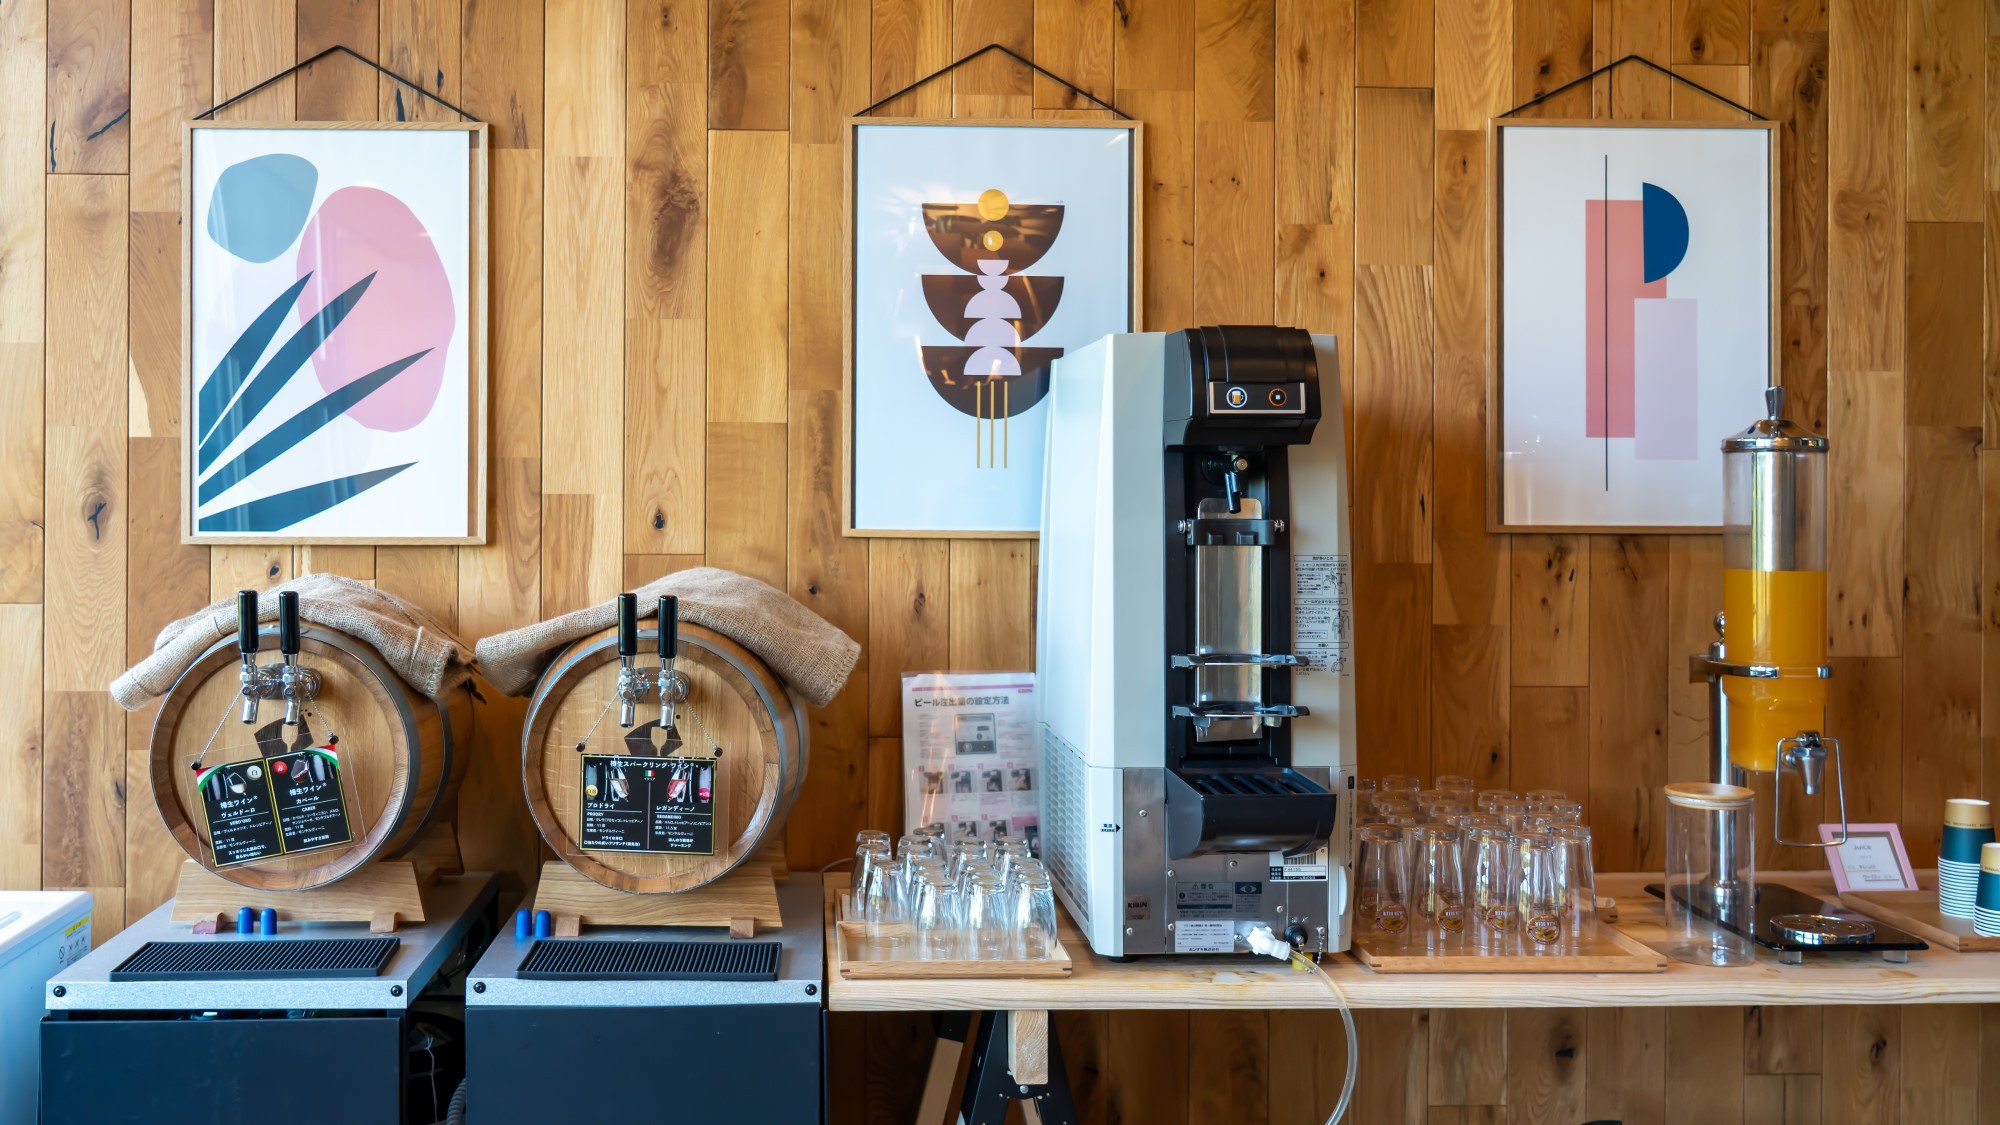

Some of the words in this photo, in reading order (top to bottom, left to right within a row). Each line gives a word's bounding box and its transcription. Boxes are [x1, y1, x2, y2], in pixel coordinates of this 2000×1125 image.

[914, 695, 1010, 708] ビール注出量の設定方法
[296, 795, 320, 805] カベール
[221, 807, 256, 819] ヴェルドーロ
[1127, 901, 1148, 909] KIRIN
